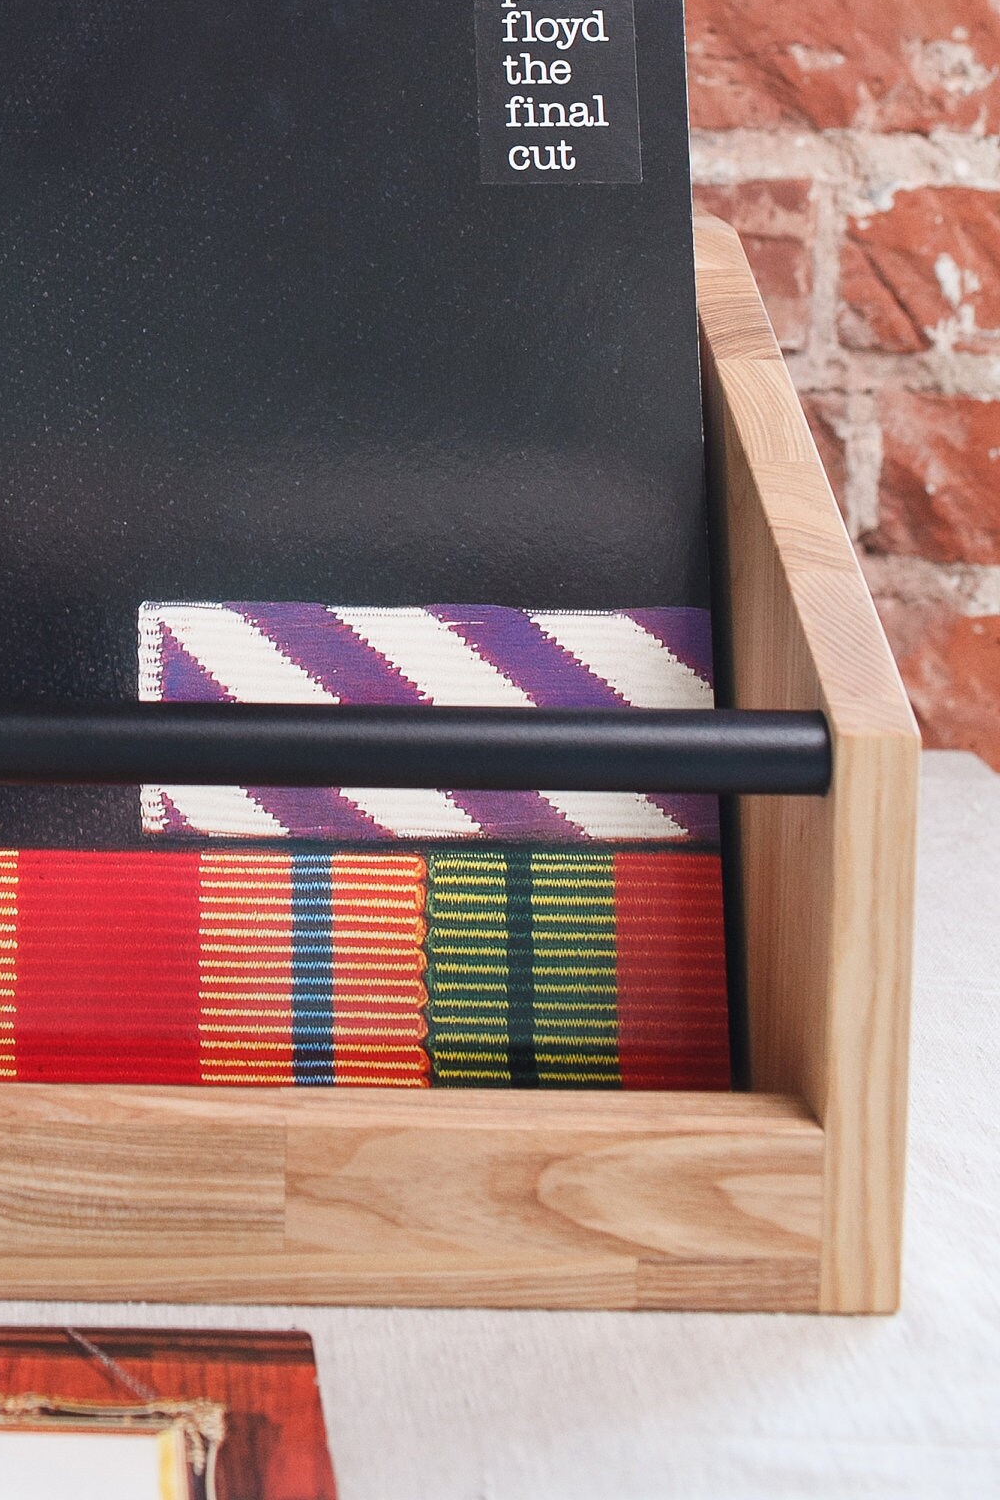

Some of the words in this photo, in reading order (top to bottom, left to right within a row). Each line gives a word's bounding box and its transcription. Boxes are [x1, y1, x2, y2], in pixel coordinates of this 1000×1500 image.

[501, 9, 610, 50] floyd
[502, 52, 572, 85] the
[505, 94, 610, 128] final
[508, 139, 577, 171] cut
